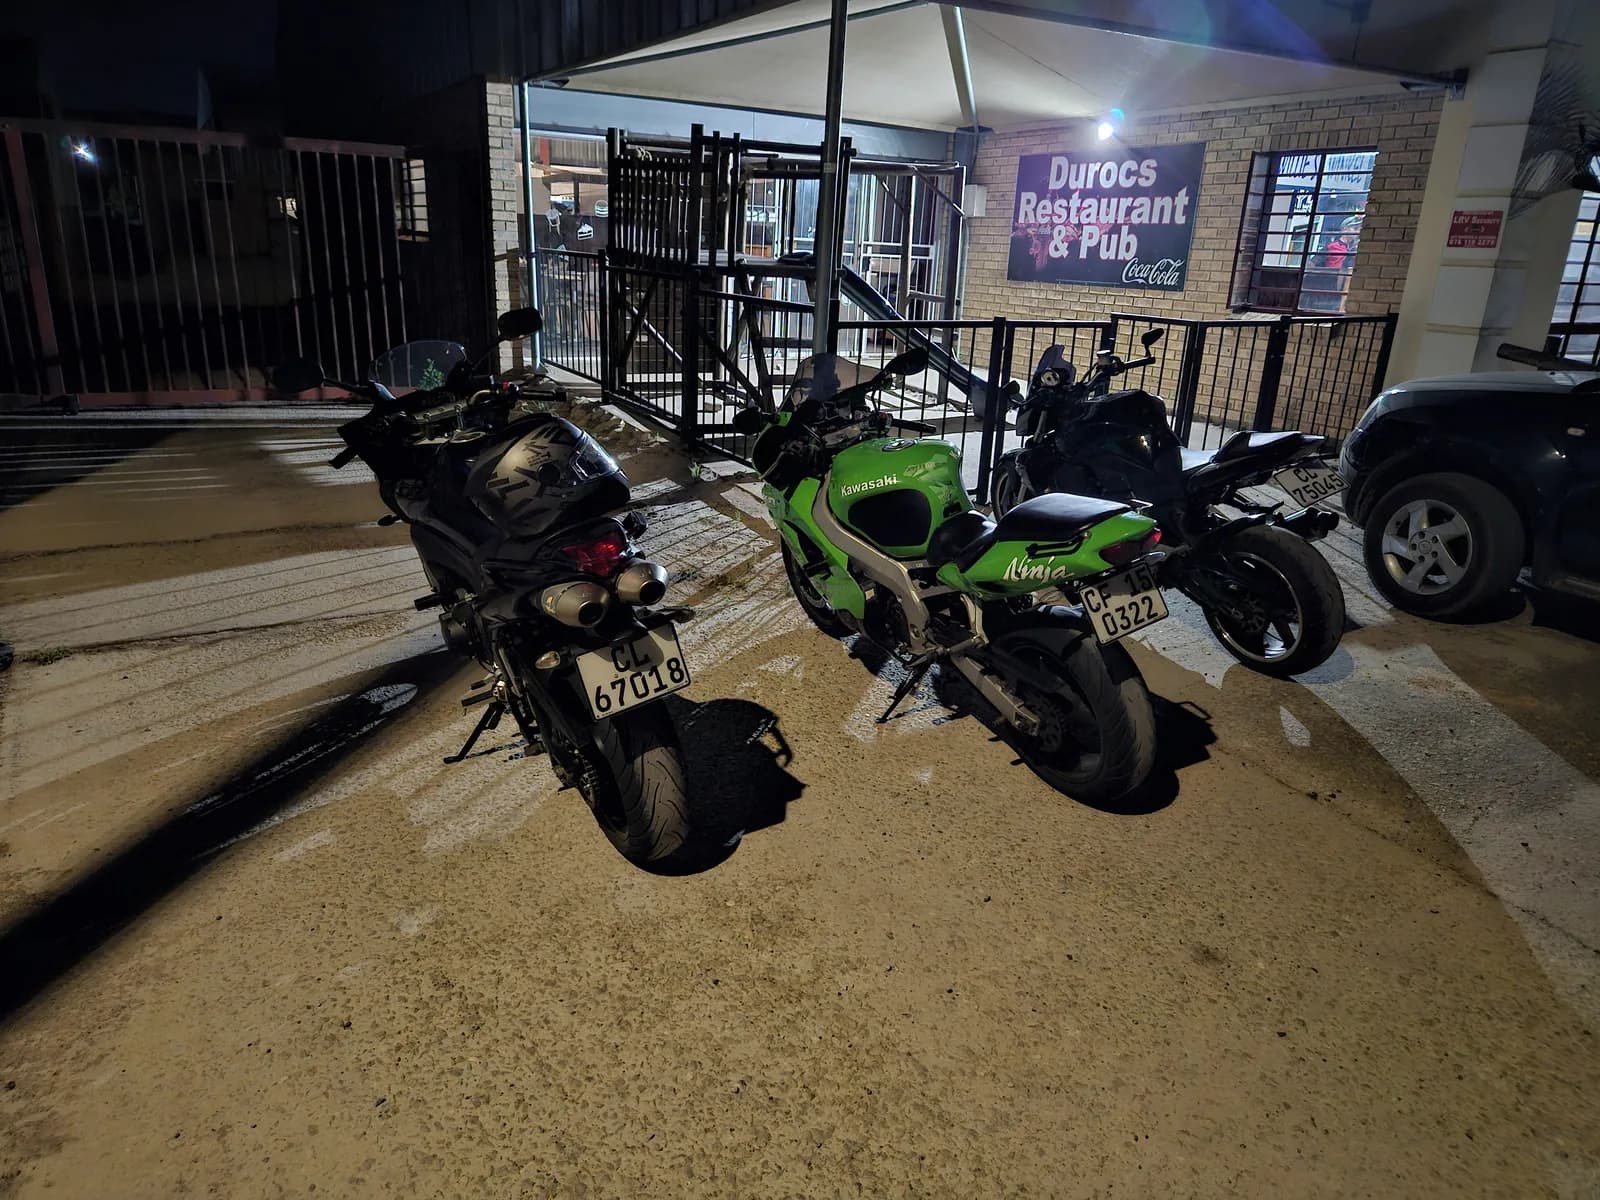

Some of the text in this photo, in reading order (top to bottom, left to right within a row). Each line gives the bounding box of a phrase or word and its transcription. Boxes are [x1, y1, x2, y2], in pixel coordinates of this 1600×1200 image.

[1049, 156, 1158, 190] Durocs
[1018, 185, 1190, 225] Restaurant
[1049, 225, 1138, 260] & Pub
[841, 473, 898, 497] Kawasaki
[1292, 474, 1345, 503] 75045
[1293, 467, 1318, 483] CL
[1003, 554, 1075, 585] Ninja
[1084, 566, 1153, 614] CF 15
[1101, 595, 1158, 637] 0322
[611, 642, 650, 672] CL
[595, 657, 685, 713] 67018
